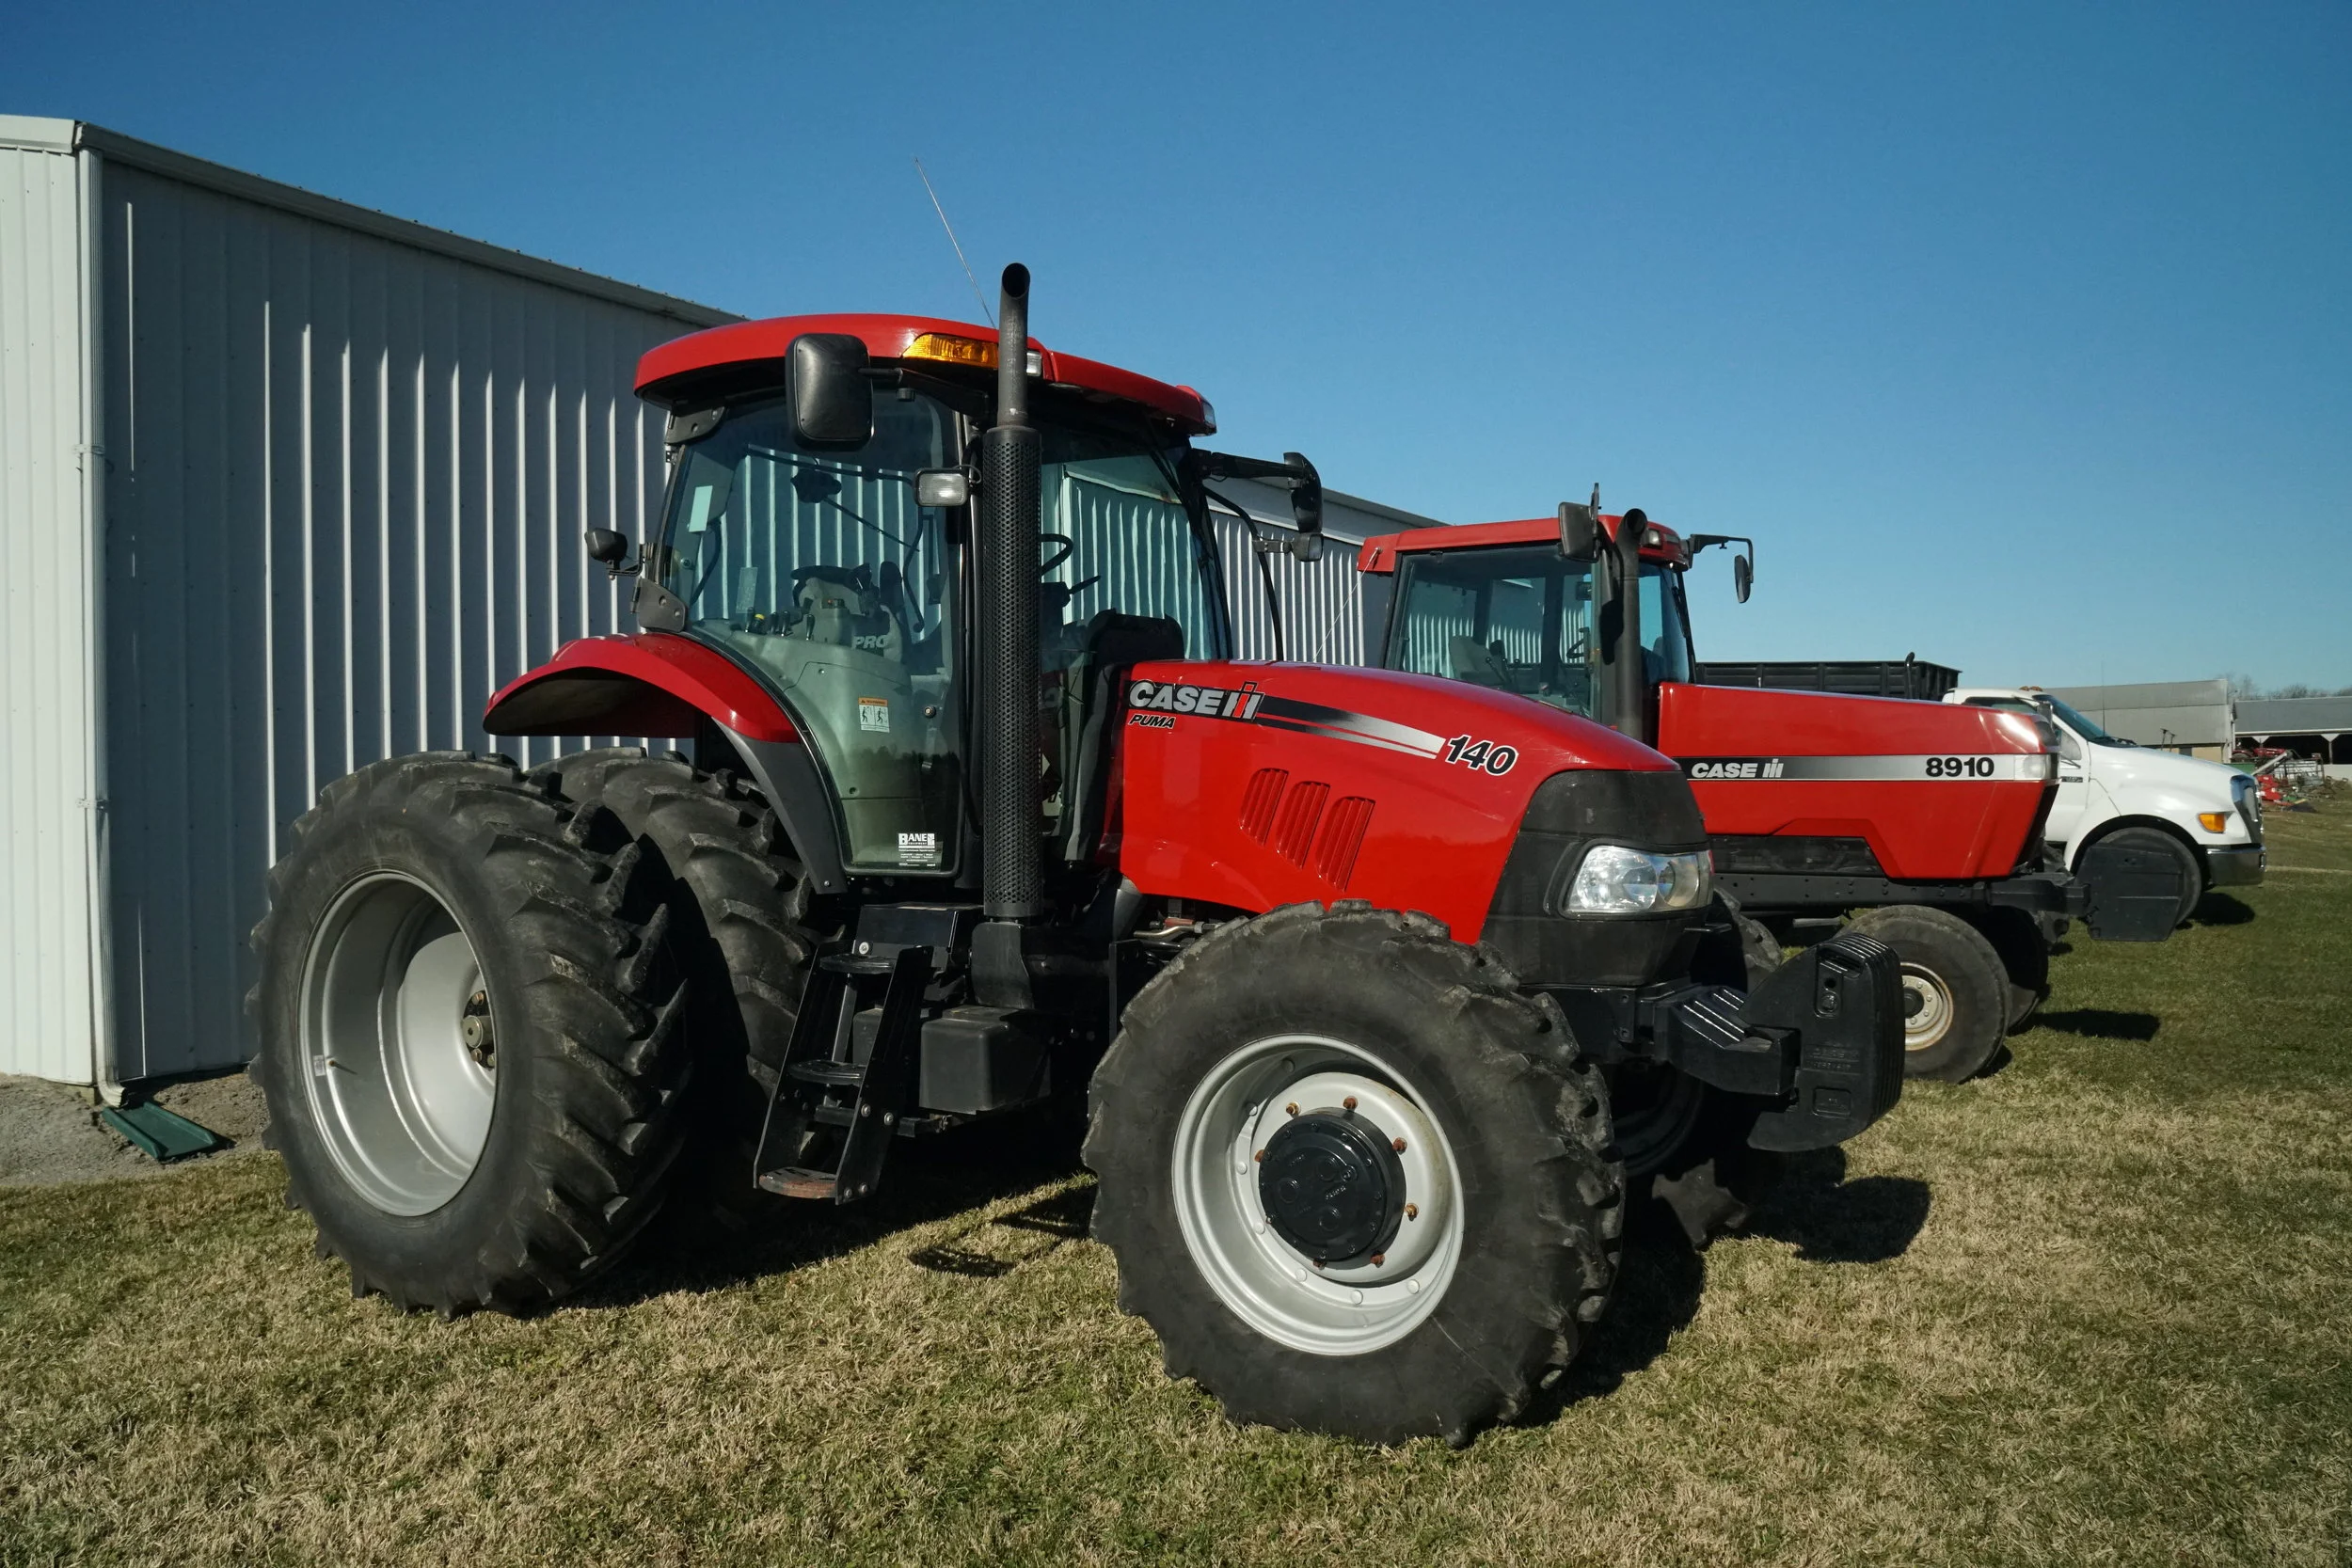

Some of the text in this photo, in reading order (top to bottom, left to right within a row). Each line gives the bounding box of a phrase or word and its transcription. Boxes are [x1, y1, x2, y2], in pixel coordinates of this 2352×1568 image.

[1129, 680, 1224, 715] CASE
[1129, 714, 1175, 728] PUMA
[1446, 735, 1518, 776] 140
[1691, 762, 1758, 779] CASE
[1926, 757, 1994, 777] 8910
[898, 833, 928, 845] BANE
